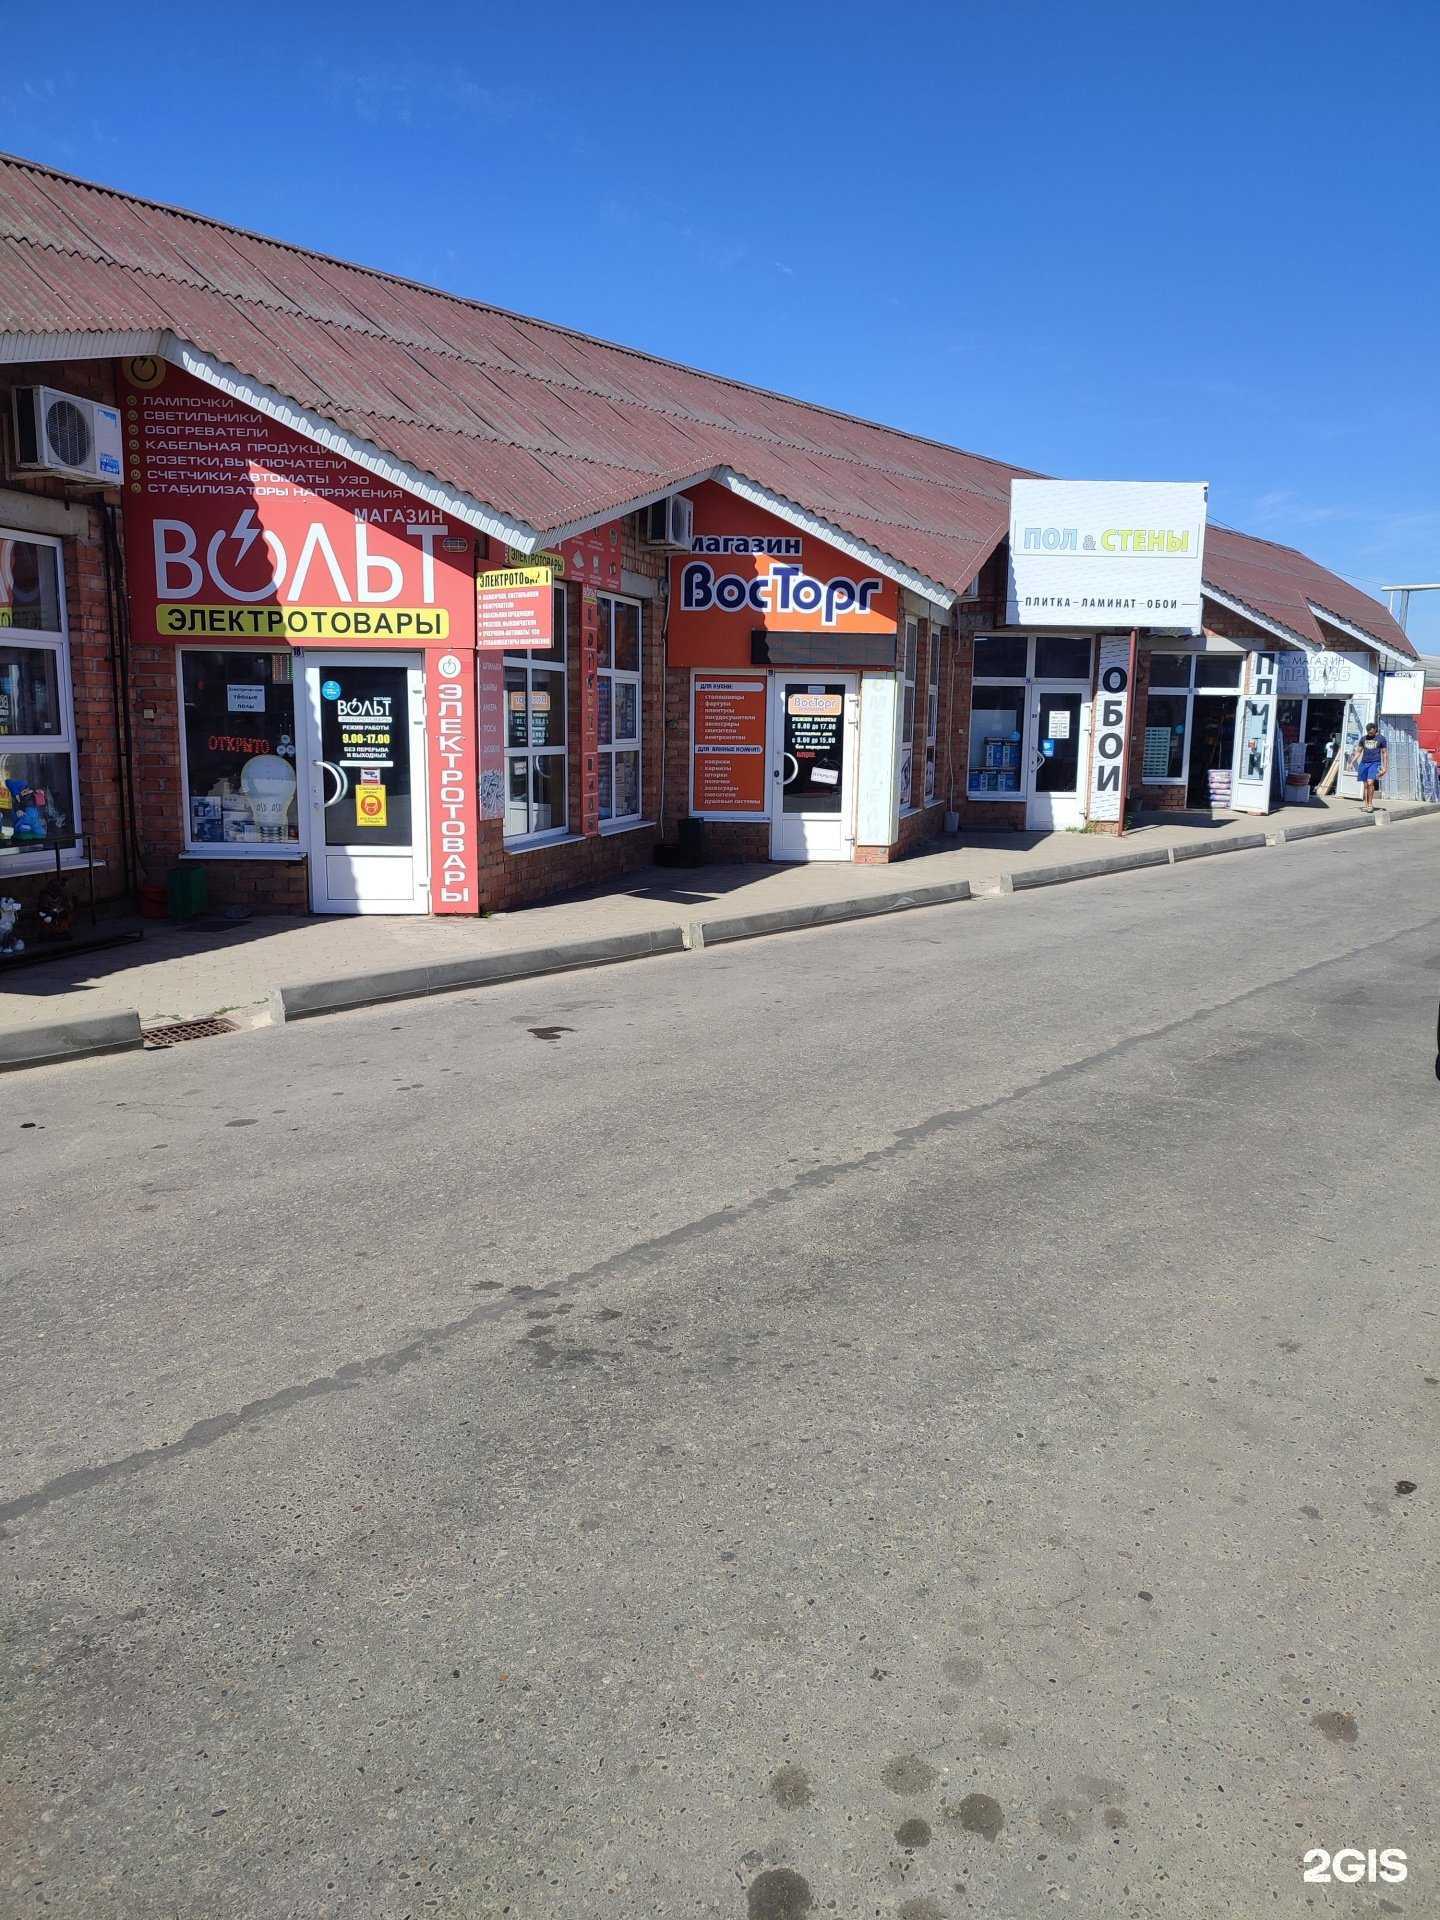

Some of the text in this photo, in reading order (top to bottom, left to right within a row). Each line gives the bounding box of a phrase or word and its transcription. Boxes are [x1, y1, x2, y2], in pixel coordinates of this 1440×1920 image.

[143, 396, 234, 408] ЛАМПОЧКИ
[143, 410, 263, 424] СВЕТИЛЬНИКИ
[144, 425, 269, 438] ОБОГРЕВАТЕЛИ
[145, 439, 338, 456] КАБЕЛЬНАЯ ПРОДУКЦИ
[338, 475, 370, 485] УЗО
[147, 483, 403, 500] СТАБИЛИЗАТОРЫ НАПРЯЖЕНИЯ
[354, 508, 443, 524] МАГАЗИН
[1023, 527, 1190, 552] ПОЛ & СТЕНЫ
[152, 511, 448, 604] ВОЛЬТ
[682, 562, 882, 625] ВосТорг
[1025, 596, 1177, 609] ПЛИТКА ЛАМИНАТ ОБОИ
[167, 607, 441, 635] ЭЛЕКТРОТОВАРЫ
[337, 698, 392, 716] ВОЛЬТ
[1097, 666, 1128, 792] ОБОИ
[437, 683, 469, 902] ЭЛЕКТРОТОВАРЫ
